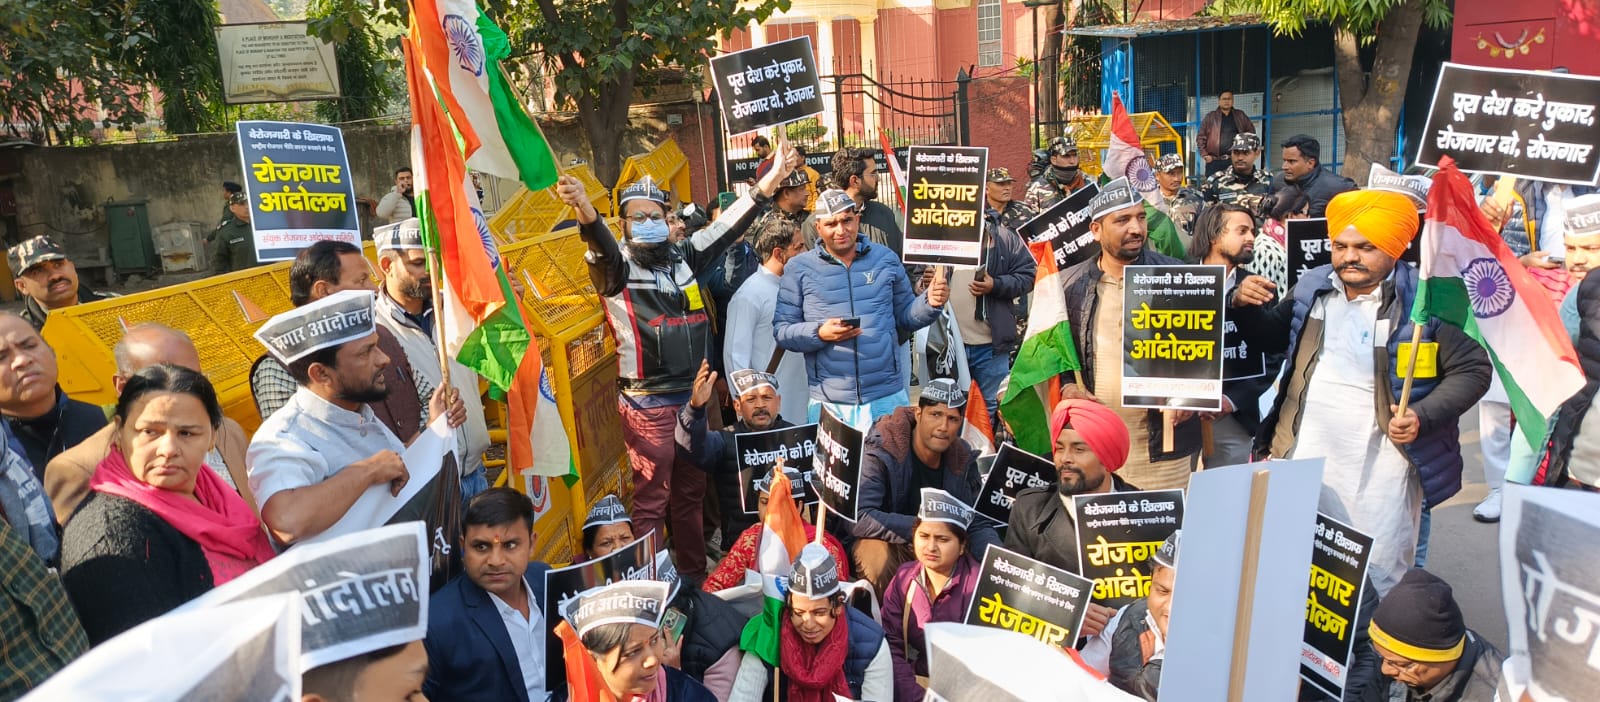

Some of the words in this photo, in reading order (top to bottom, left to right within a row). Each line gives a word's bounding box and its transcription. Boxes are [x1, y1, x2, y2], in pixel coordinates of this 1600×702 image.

[727, 72, 746, 95] पूरा
[746, 65, 764, 84] देश
[764, 59, 780, 80] करे
[780, 58, 806, 83] पुकार,
[731, 99, 769, 119] रोजगार
[769, 89, 784, 109] दो,
[784, 85, 816, 106] रोजगार
[1453, 92, 1482, 122] पूरा
[1482, 89, 1512, 116] देश
[1512, 92, 1545, 119] करे
[1542, 100, 1595, 131] पुकार,
[248, 128, 290, 139] बेरोजगारी
[292, 130, 302, 139] के
[303, 130, 334, 142] खिलाफ
[1436, 124, 1499, 154] रोजगार
[1498, 130, 1520, 158] दो,
[1526, 133, 1593, 163] रोजगार
[252, 156, 341, 184] रोजगार
[736, 162, 747, 170] NO
[805, 156, 830, 166] RONT
[258, 185, 347, 212] आंदोलन
[913, 177, 979, 202] रोजगार
[912, 203, 977, 226] आंदोलन
[1056, 217, 1070, 232] को
[1300, 239, 1322, 260] पूरा
[1133, 273, 1172, 285] बेरोजगारी
[1173, 273, 1183, 284] के
[1185, 272, 1216, 285] खिलाफ
[308, 307, 370, 336] आंदोलन
[1130, 302, 1216, 330] रोजगार
[1130, 333, 1215, 361] आंदोलन
[789, 442, 803, 459] को
[1005, 466, 1028, 488] पूरा
[990, 488, 1016, 510] रोज
[1084, 500, 1127, 515] बेरोजगारी
[1128, 500, 1139, 513] के
[1140, 499, 1175, 513] खिलाफ
[1086, 535, 1165, 566] रोजगा
[1334, 530, 1364, 554] खिलाफ
[993, 556, 1034, 582] बेरोजगारी
[1035, 572, 1046, 586] के
[1046, 576, 1080, 598] खिलाफ
[1092, 568, 1152, 600] आंदो
[594, 591, 657, 612] आंदोलन
[979, 592, 1070, 648] रोजगार
